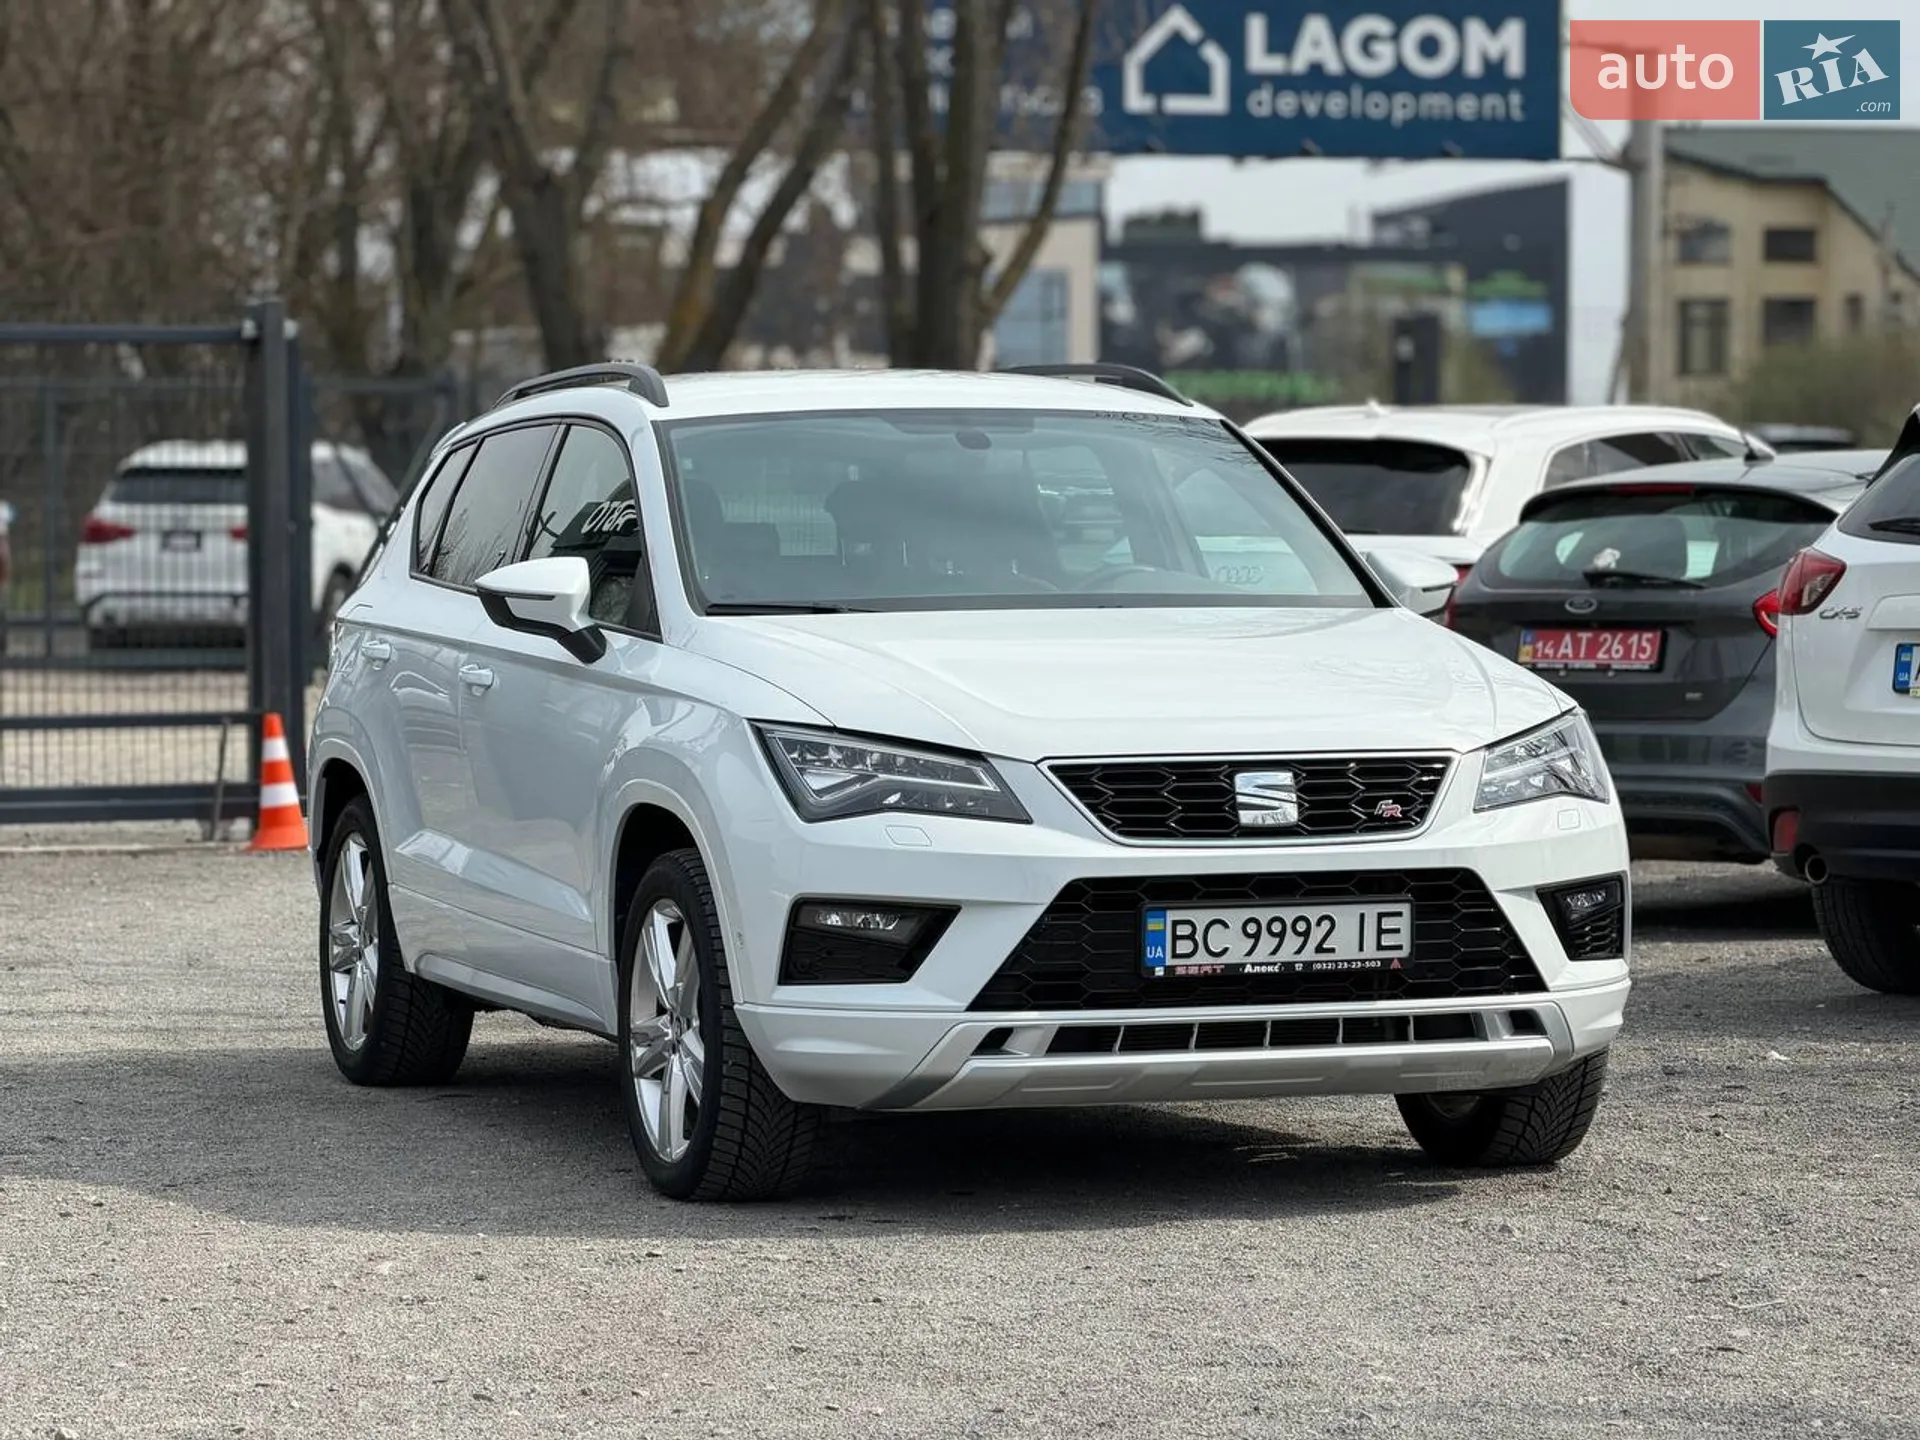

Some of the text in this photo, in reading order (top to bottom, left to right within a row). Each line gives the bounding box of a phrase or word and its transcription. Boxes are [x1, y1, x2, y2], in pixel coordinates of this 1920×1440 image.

[1245, 12, 1526, 79] LAGOM
[1246, 82, 1524, 128] development
[1596, 632, 1654, 660] 2615
[1146, 945, 1164, 959] UA
[1170, 911, 1404, 960] BC 9992 IE
